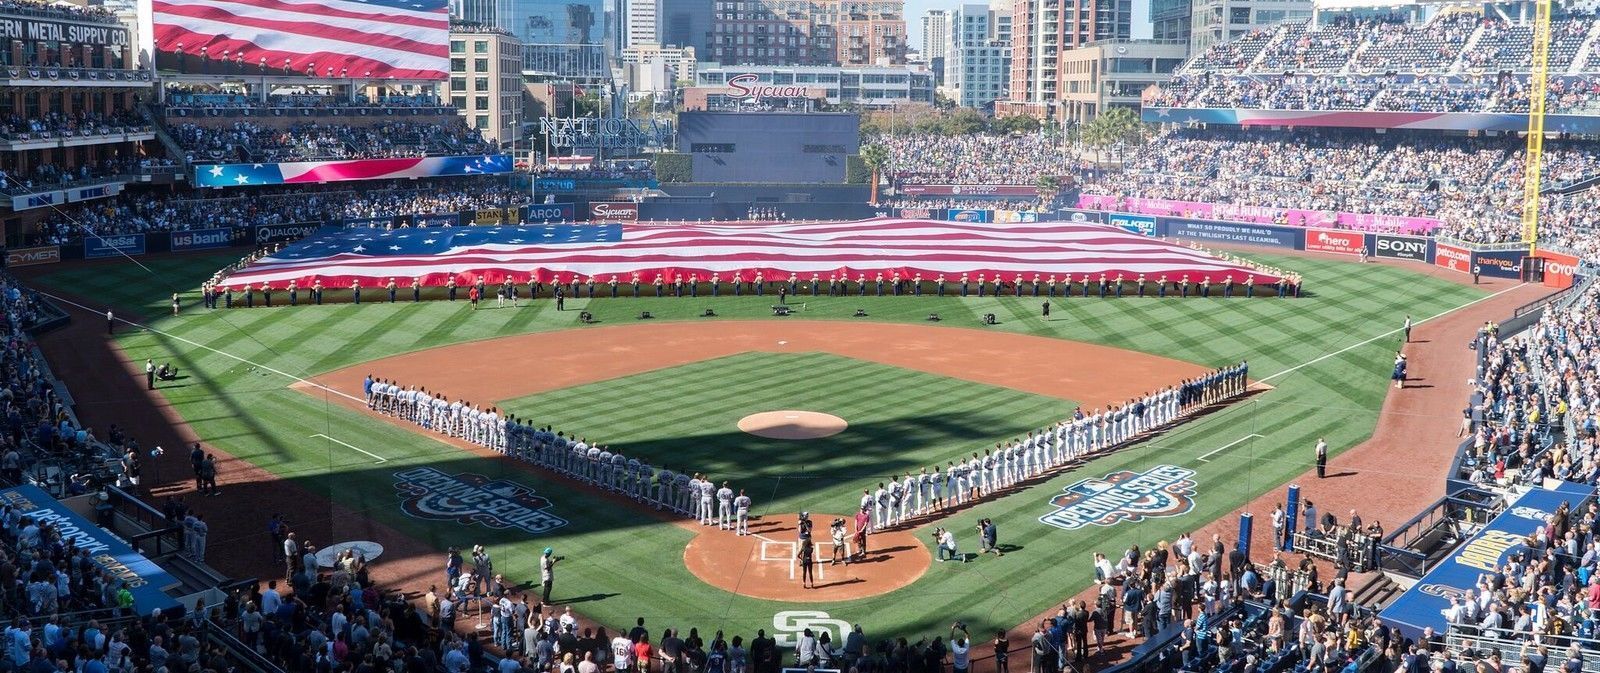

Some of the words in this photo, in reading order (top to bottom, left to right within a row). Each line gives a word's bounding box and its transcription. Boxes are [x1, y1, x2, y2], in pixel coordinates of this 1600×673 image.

[28, 22, 66, 42] METAL
[68, 26, 108, 44] SUPPLY
[112, 30, 128, 46] CO.
[727, 74, 810, 102] Sycuan
[539, 116, 677, 135] NATIONAL
[551, 134, 665, 148] UNIVERSITY
[530, 208, 561, 219] ARCO
[592, 204, 636, 218] Sycuan
[1199, 232, 1231, 240] TWILIGHT'S
[1326, 236, 1350, 246] hero
[1378, 239, 1426, 254] SONY
[1437, 247, 1470, 262] petco.com
[1477, 257, 1513, 267] thankyou
[1544, 262, 1576, 276] TOYOT
[402, 468, 494, 502] OPENING
[476, 498, 562, 531] SERIES
[1043, 488, 1136, 528] OPENING
[1120, 466, 1192, 495] SERIES
[1455, 530, 1530, 572] PADRES
[774, 610, 852, 656] SD
[616, 647, 624, 656] 16
